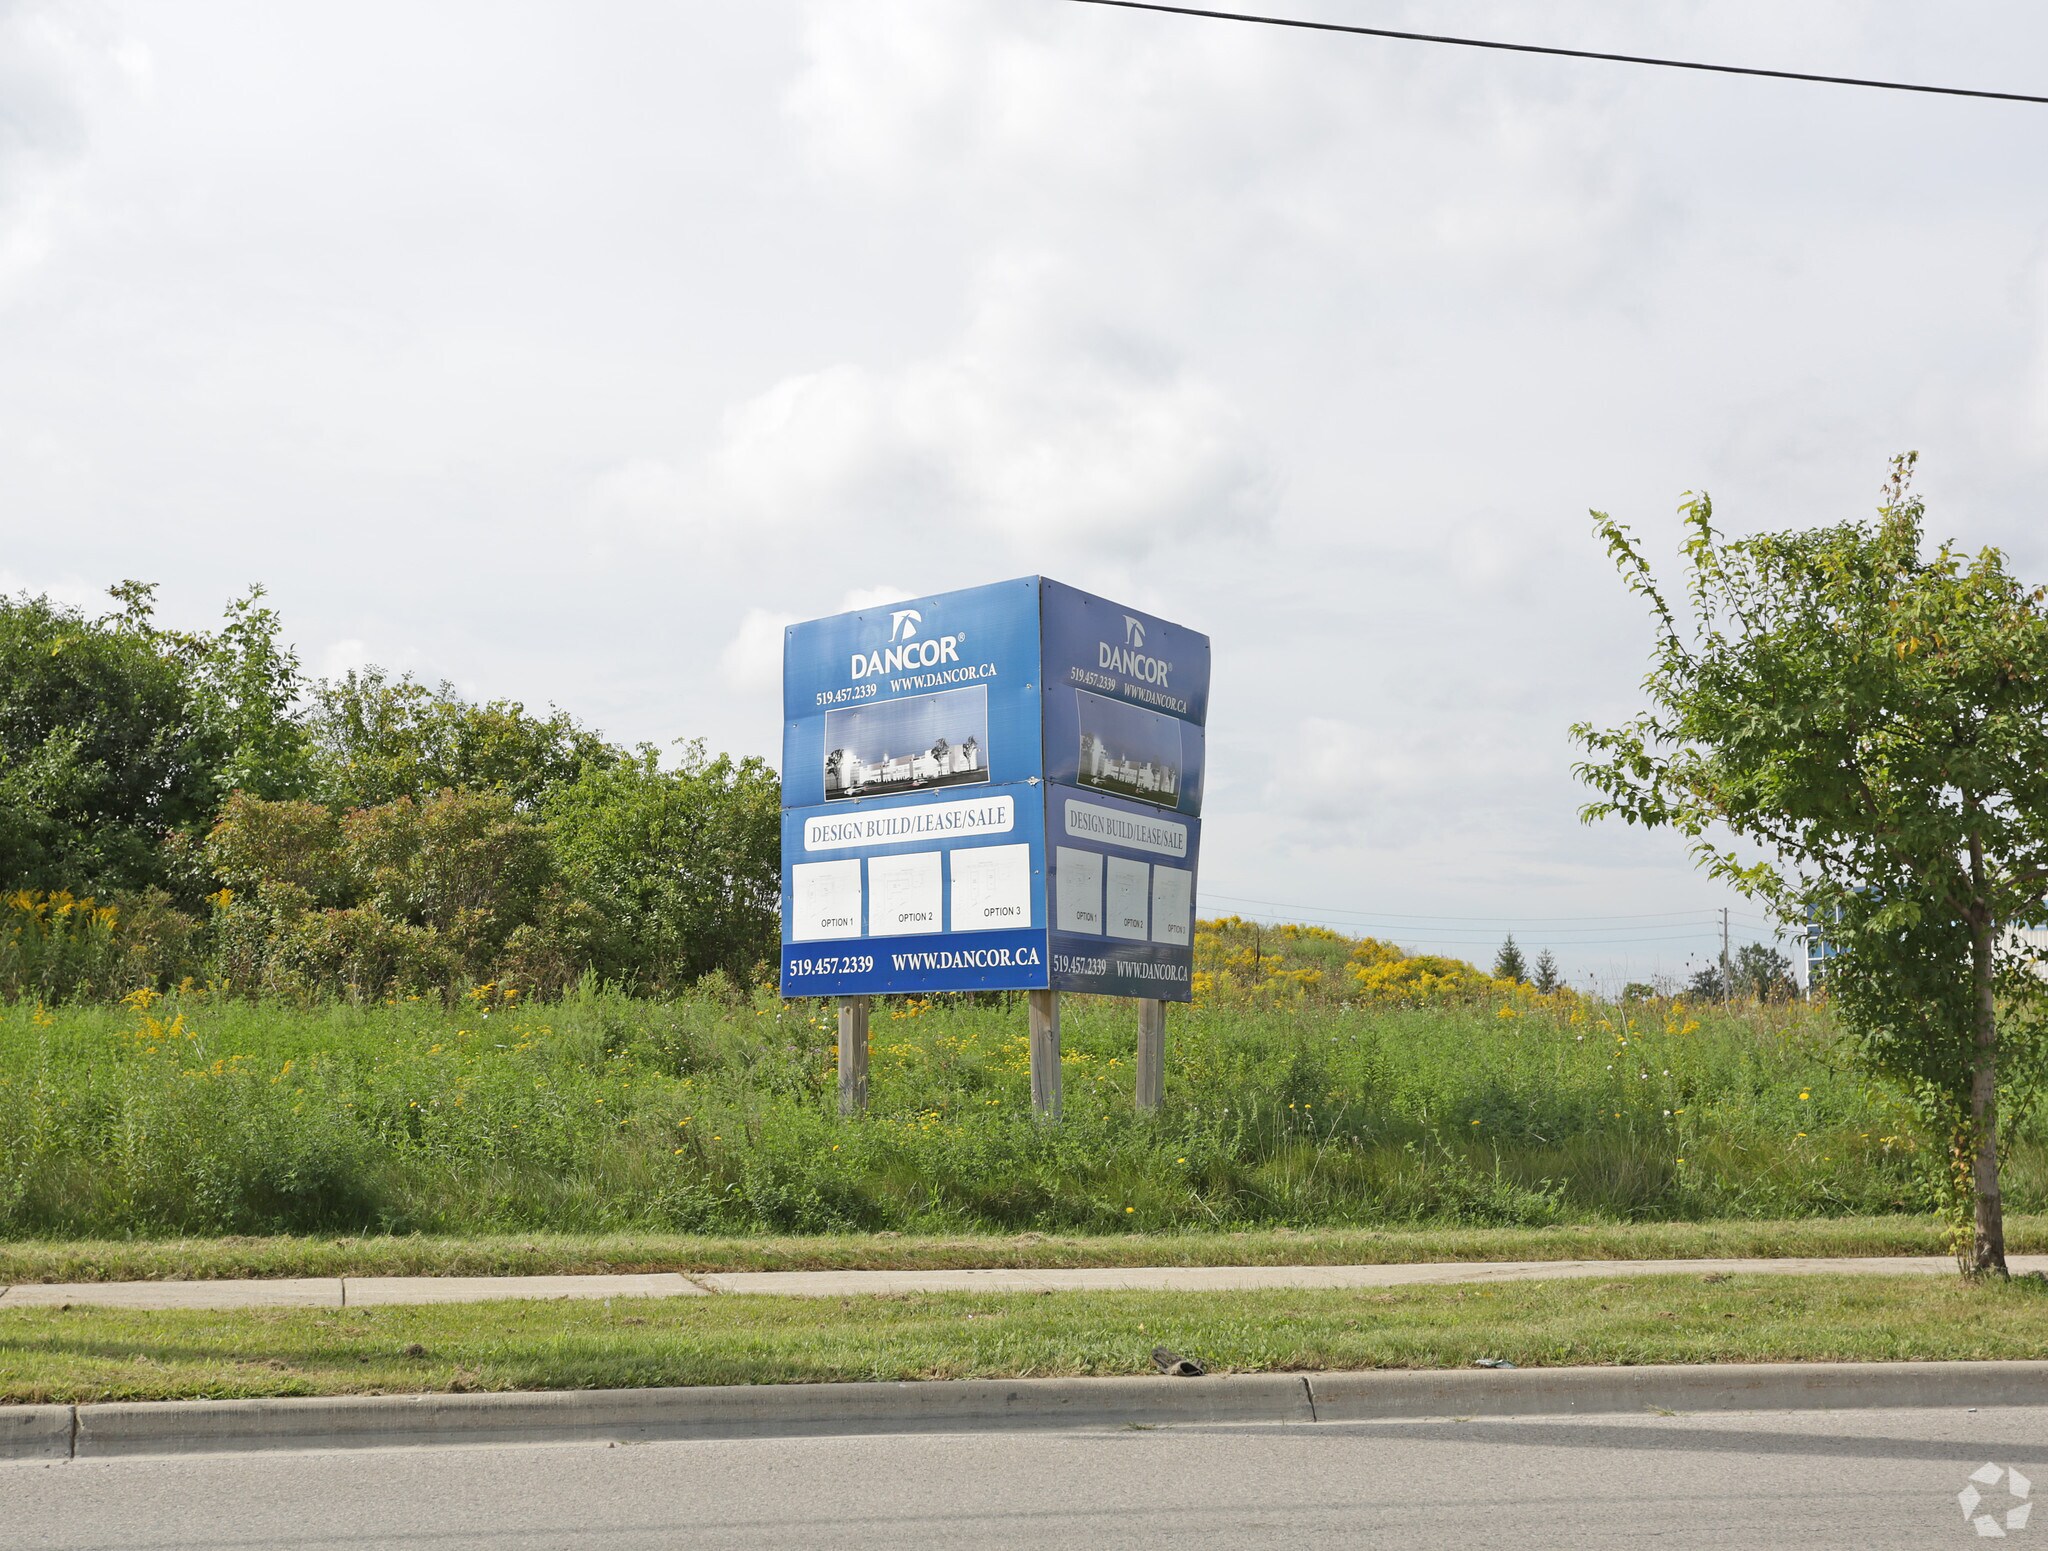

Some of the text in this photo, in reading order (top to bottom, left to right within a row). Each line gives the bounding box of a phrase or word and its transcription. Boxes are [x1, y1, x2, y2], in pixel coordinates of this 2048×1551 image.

[816, 662, 997, 706] 519.457.2339 WWW.DANCOR.CA
[1070, 666, 1187, 714] 519.457.2339 WWW.DANCOR.CA
[812, 806, 1006, 843] DESIGN BUILD/LEASE/SALE
[1070, 810, 1183, 850] DESIGN BUILD/LEASE/SALE
[898, 912, 933, 922] OPTION 2
[984, 906, 1021, 917] OPTION 3
[1076, 911, 1097, 922] OPTION 1
[821, 917, 854, 928] OPTION 1
[1124, 918, 1143, 928] OPTION 2
[1168, 924, 1182, 934] OPTION
[790, 947, 1040, 977] 519.457.2339 WWW.DANCOR.CA
[1053, 955, 1188, 982] 519.457.2339 WWW.DANCOR.CA
